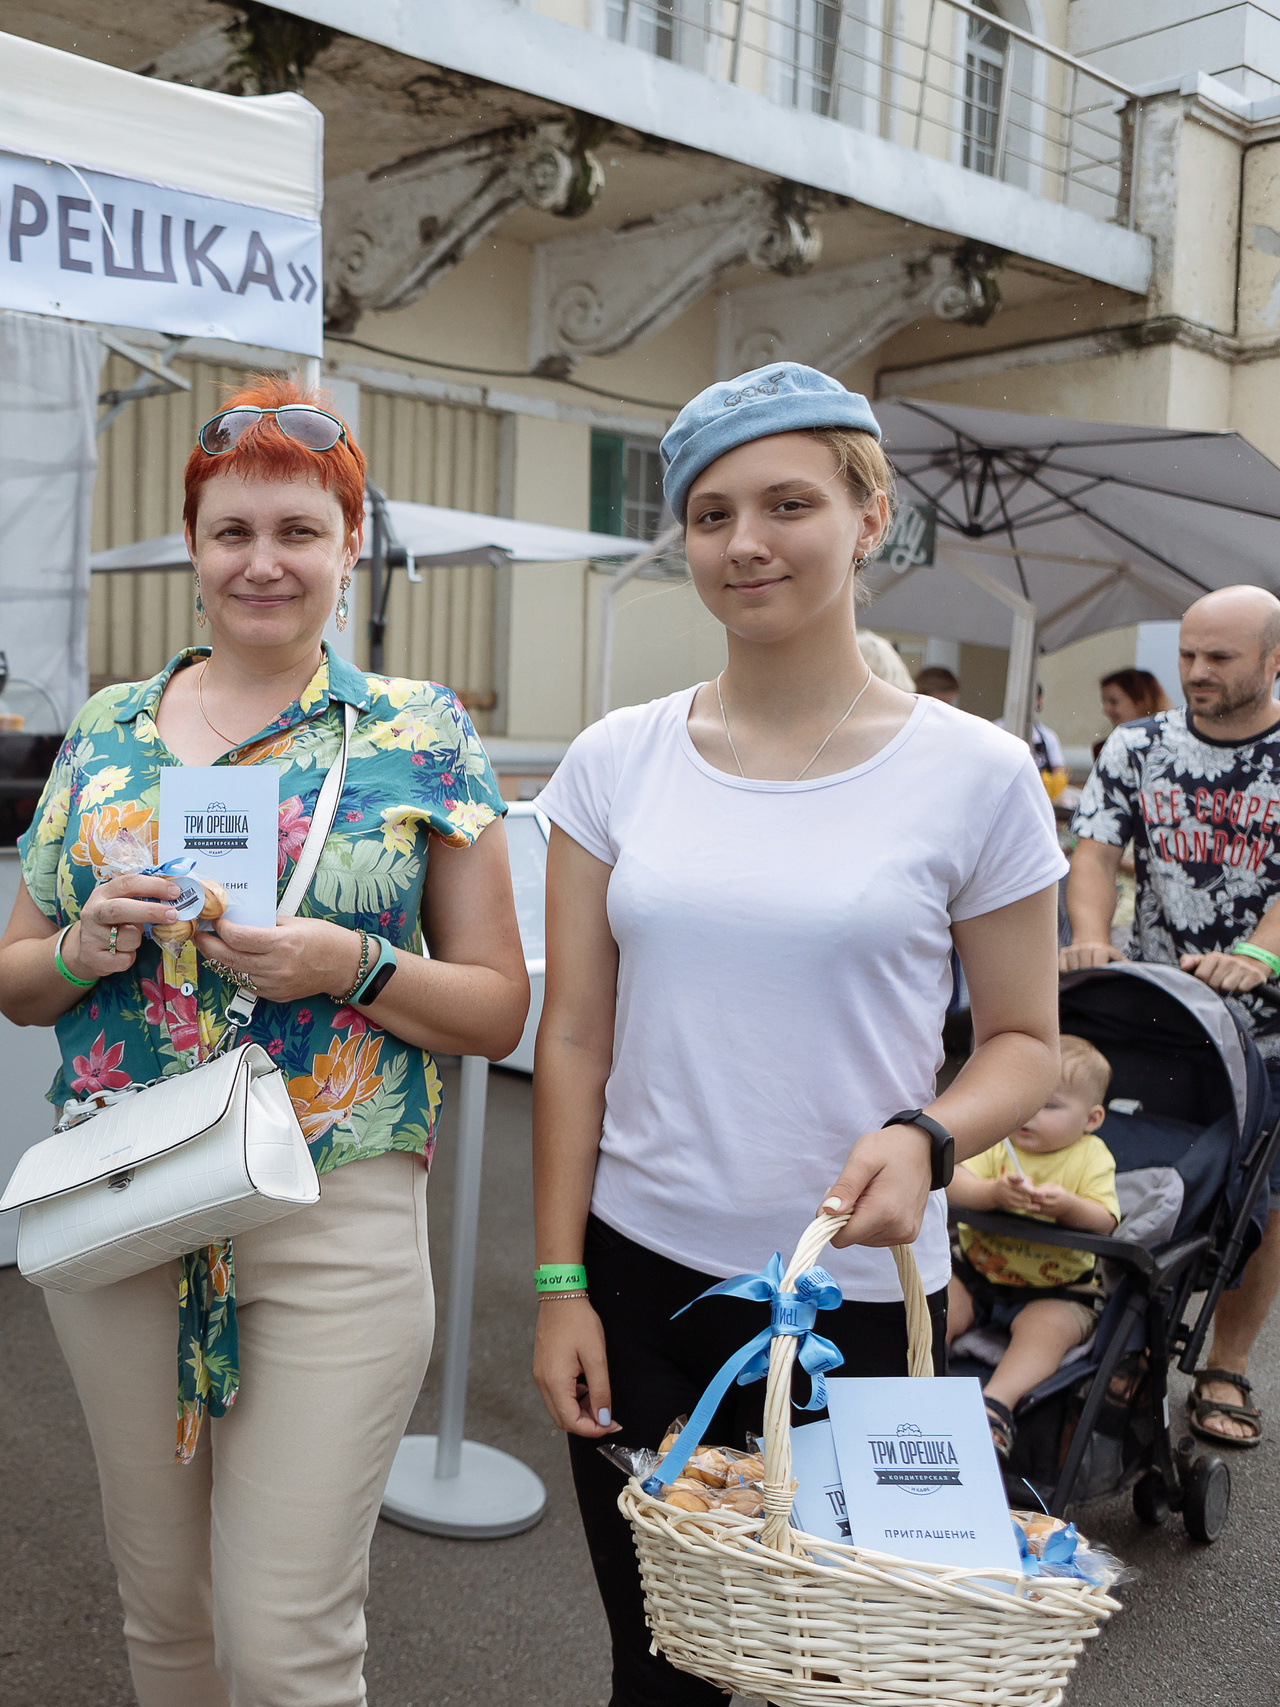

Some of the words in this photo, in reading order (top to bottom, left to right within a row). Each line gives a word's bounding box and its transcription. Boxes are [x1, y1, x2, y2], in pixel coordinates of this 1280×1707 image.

[184, 815, 204, 834] ТРИ
[206, 814, 249, 834] ОРЕШКА
[1140, 788, 1182, 825] LEE
[1194, 788, 1280, 836] COOPE
[1159, 829, 1269, 873] LONDON
[780, 1308, 799, 1327] ТРИ
[868, 1440, 898, 1465] ТРИ
[899, 1440, 959, 1465] ОРЕШКА
[825, 1489, 846, 1516] ТР
[884, 1529, 977, 1540] ПРИГЛАШЕНИЕ
